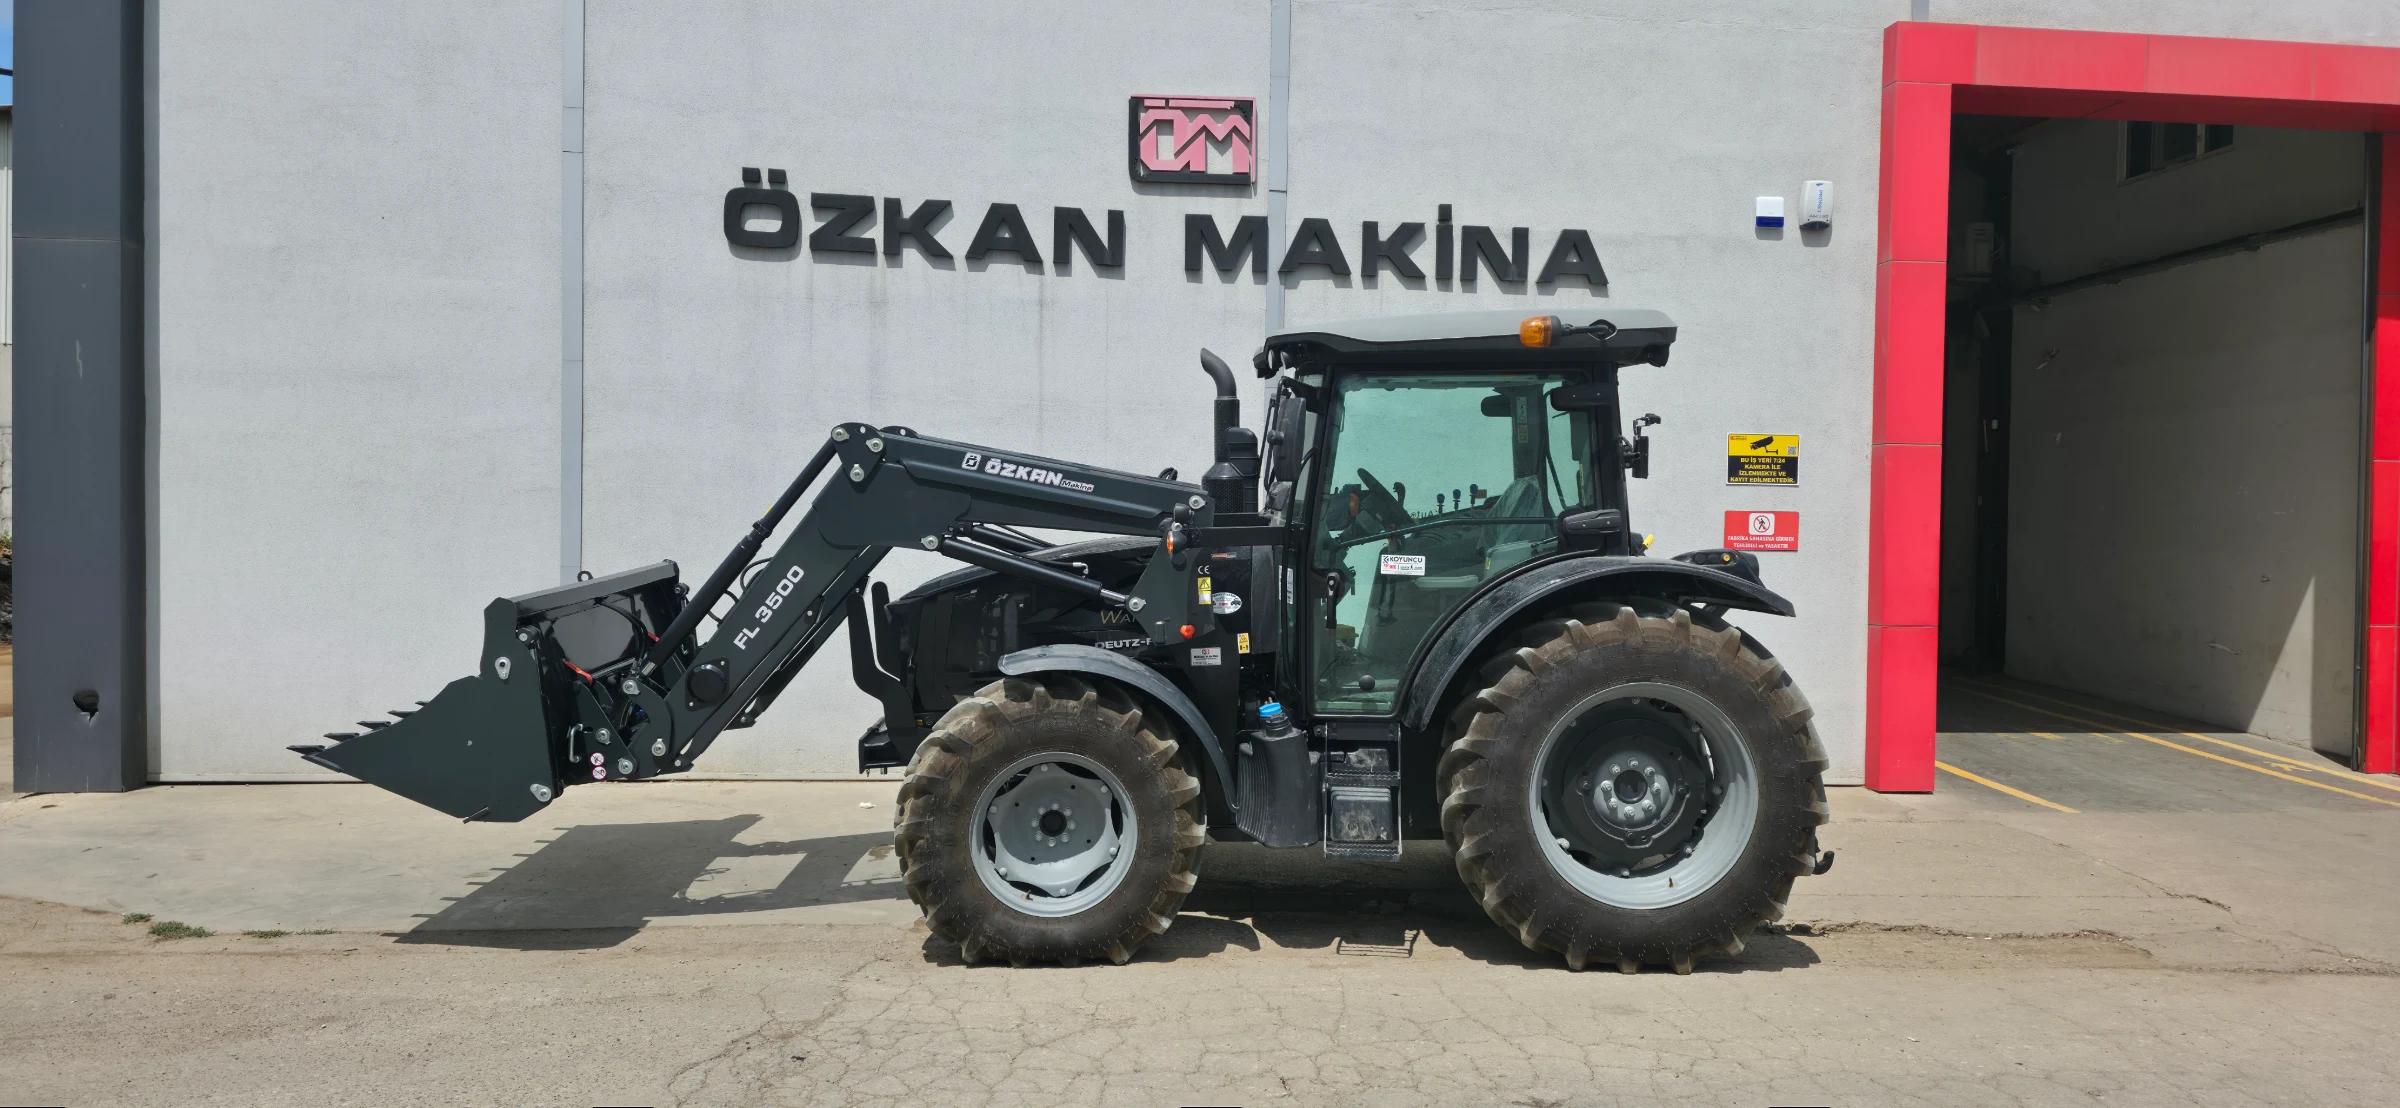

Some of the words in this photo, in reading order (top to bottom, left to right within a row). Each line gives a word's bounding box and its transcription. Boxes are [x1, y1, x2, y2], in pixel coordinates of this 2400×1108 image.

[723, 166, 1126, 272] ÖZKAN
[1184, 204, 1609, 290] MAKİNA
[984, 457, 1063, 486] ÖZKAN
[1061, 479, 1094, 492] Makina
[1750, 456, 1757, 464] İŞ
[1197, 565, 1210, 575] CE
[733, 626, 760, 650] FL
[755, 565, 804, 623] 3500
